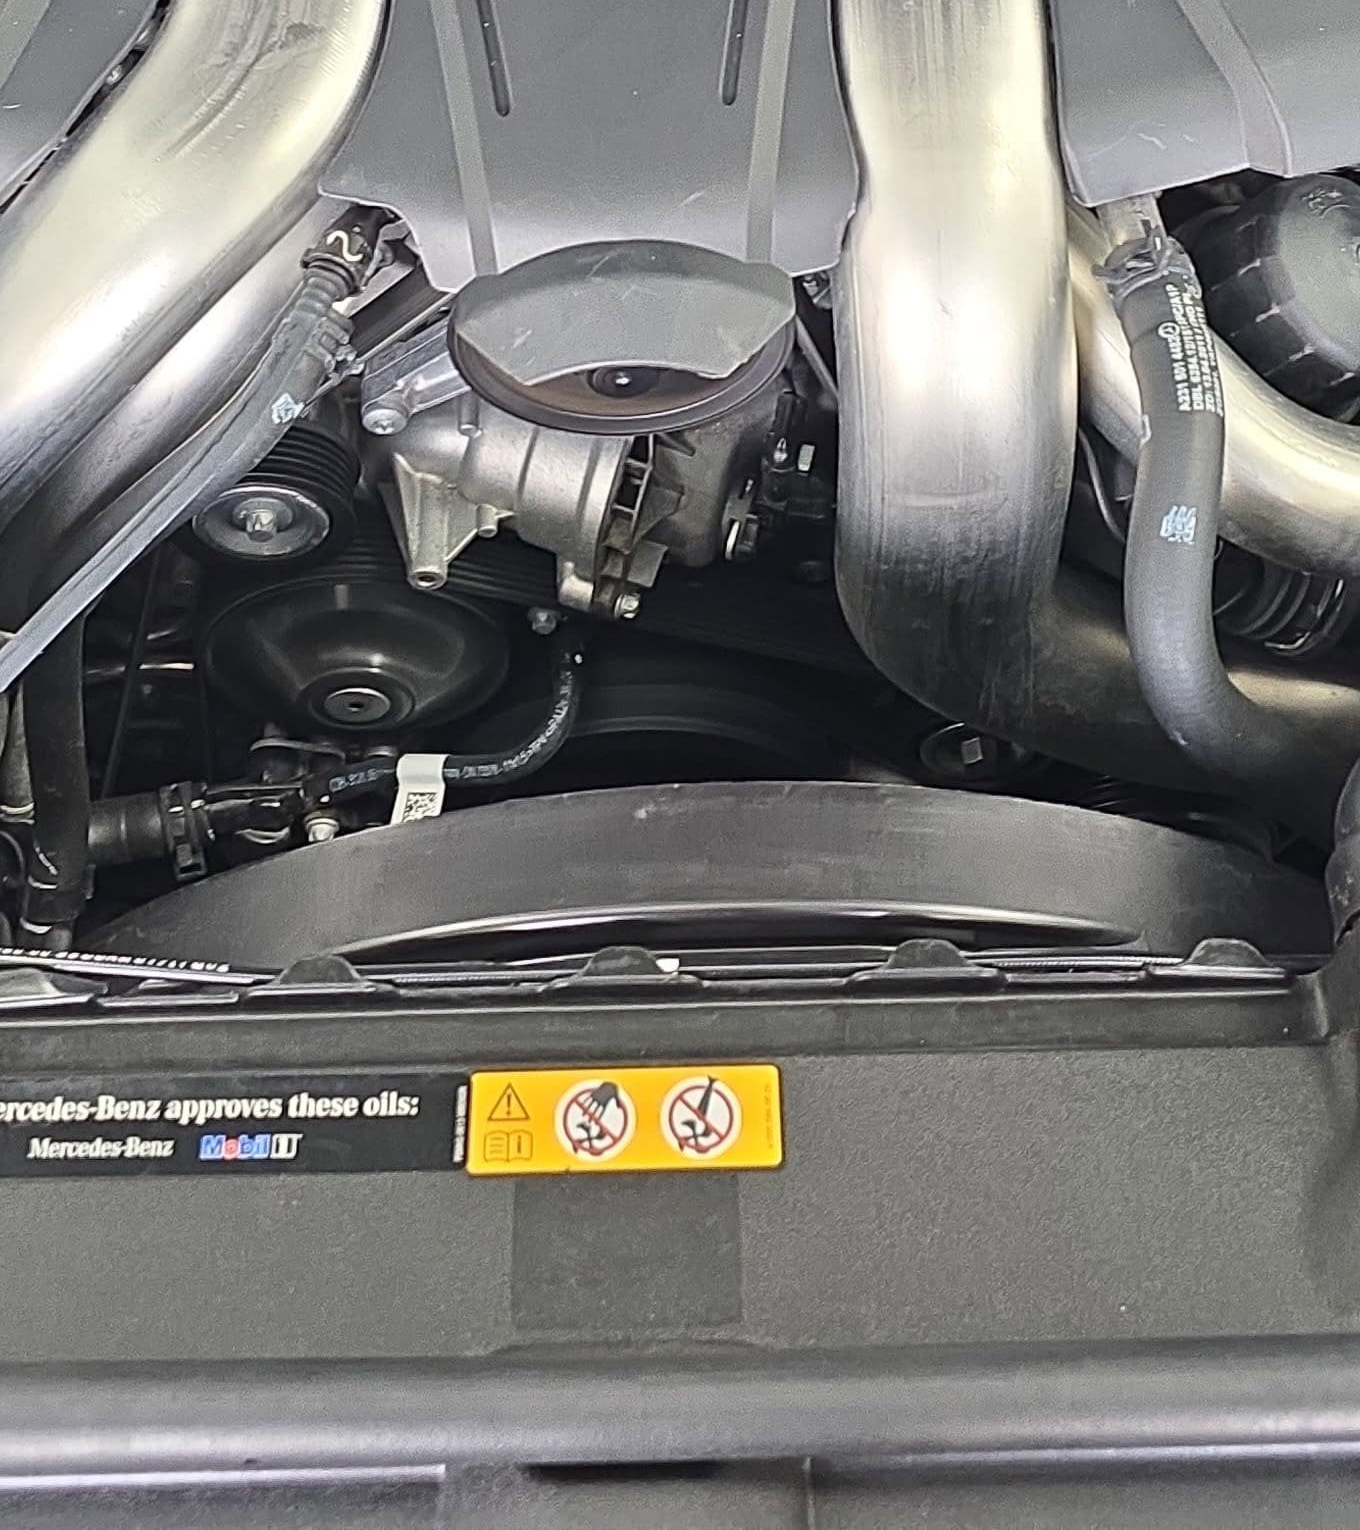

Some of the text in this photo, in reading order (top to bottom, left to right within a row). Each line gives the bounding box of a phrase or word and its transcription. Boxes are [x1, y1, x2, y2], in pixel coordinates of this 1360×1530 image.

[163, 1096, 283, 1126] approves
[288, 1092, 358, 1118] these
[362, 1090, 420, 1117] oils:
[26, 1136, 175, 1159] Mercedes-Benz
